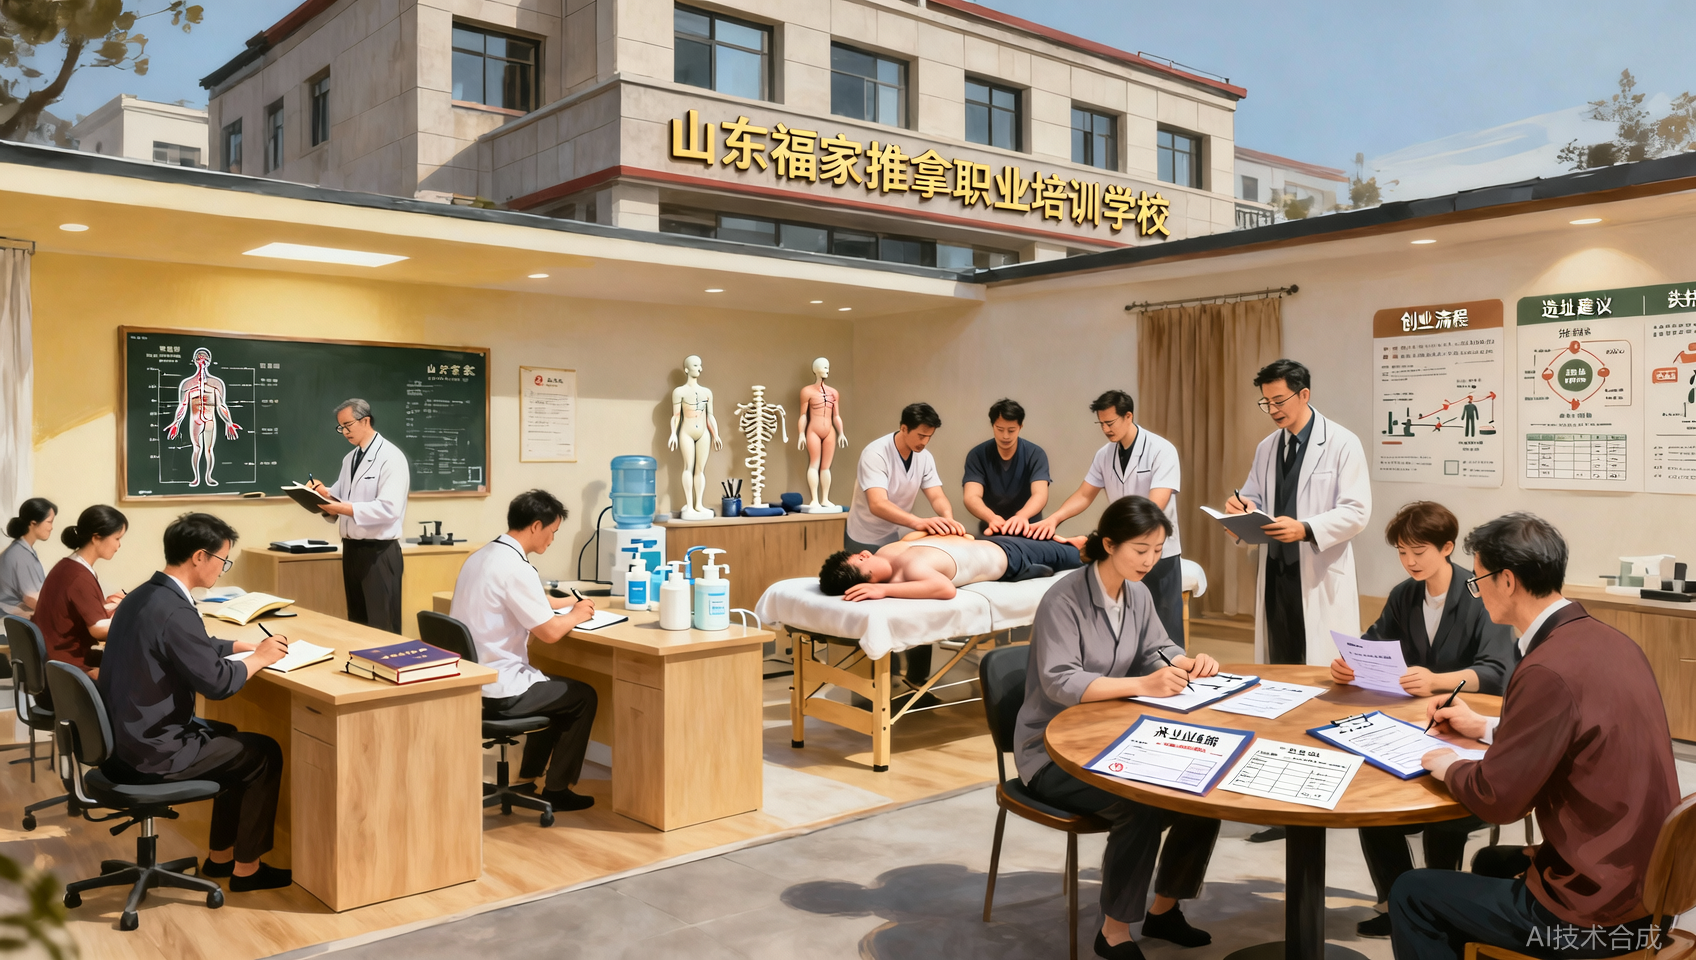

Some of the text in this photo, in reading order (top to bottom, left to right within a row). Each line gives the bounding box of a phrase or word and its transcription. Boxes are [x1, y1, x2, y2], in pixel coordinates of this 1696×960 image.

[671, 108, 1171, 237] 山东福家推拿职业培训学校
